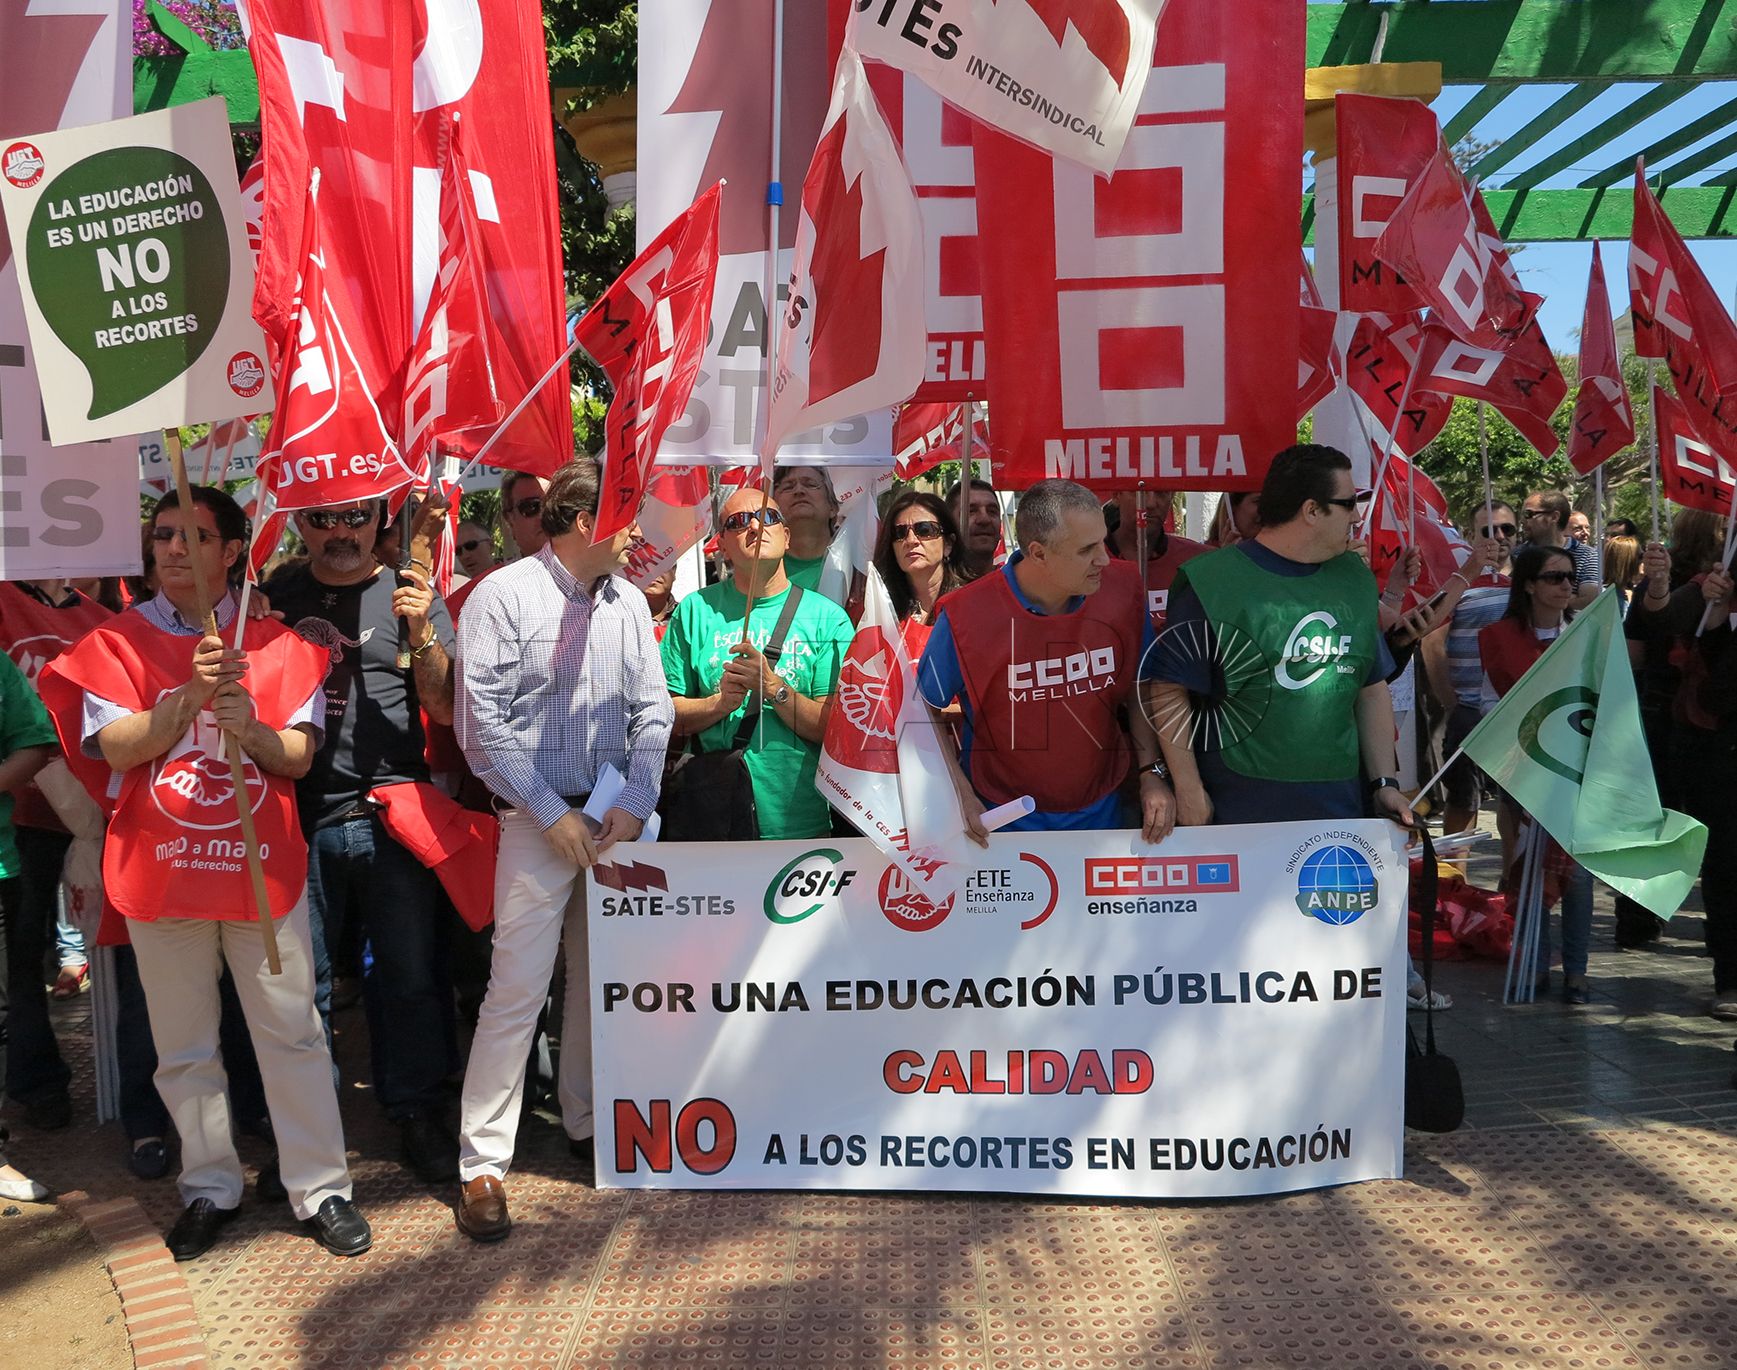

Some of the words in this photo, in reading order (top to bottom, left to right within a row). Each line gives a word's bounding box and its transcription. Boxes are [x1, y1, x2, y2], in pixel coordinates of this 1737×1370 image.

[965, 55, 1106, 147] INTERSINDICAL
[17, 175, 40, 188] MELILLA
[48, 199, 76, 221] LA
[79, 174, 193, 215] EDUCACIÓN
[47, 227, 74, 248] ES
[78, 220, 108, 242] UN
[113, 200, 204, 238] DERECHO
[96, 237, 171, 293] NO
[111, 300, 126, 319] A
[130, 292, 168, 313] LOS
[95, 313, 199, 348] RECORTES
[239, 386, 260, 396] MELILLA
[1045, 434, 1247, 480] MELILLA
[1007, 647, 1115, 688] CCOO
[1008, 675, 1116, 702] MELILLA
[825, 774, 852, 801] fundador
[852, 801, 863, 811] de
[864, 810, 874, 821] la
[876, 821, 891, 837] CES
[192, 843, 202, 855] a
[207, 839, 270, 860] mao
[1286, 834, 1322, 874] SINDICATO
[1323, 831, 1385, 872] INDEPENDIENTE
[191, 859, 242, 872] derechos
[1092, 864, 1190, 888] CCOO
[601, 895, 736, 917] SATE-STEs
[966, 889, 1034, 903] Enseñanza
[966, 906, 998, 914] MELILLA
[1087, 896, 1198, 915] enseñanza
[1307, 892, 1373, 909] ANPE
[603, 982, 697, 1013] POR
[711, 981, 810, 1013] UNA
[826, 968, 1096, 1011] EDUCACIÓN
[1113, 966, 1319, 1006] PÚBLICA
[1333, 967, 1383, 999] DE
[883, 1049, 1155, 1095] CALIDAD
[613, 1097, 738, 1176] NO
[762, 1134, 787, 1165] A
[800, 1134, 867, 1166] LOS
[880, 1135, 1074, 1170] RECORTES
[1087, 1137, 1135, 1170] EN
[1150, 1124, 1352, 1172] EDUCACIÓN
